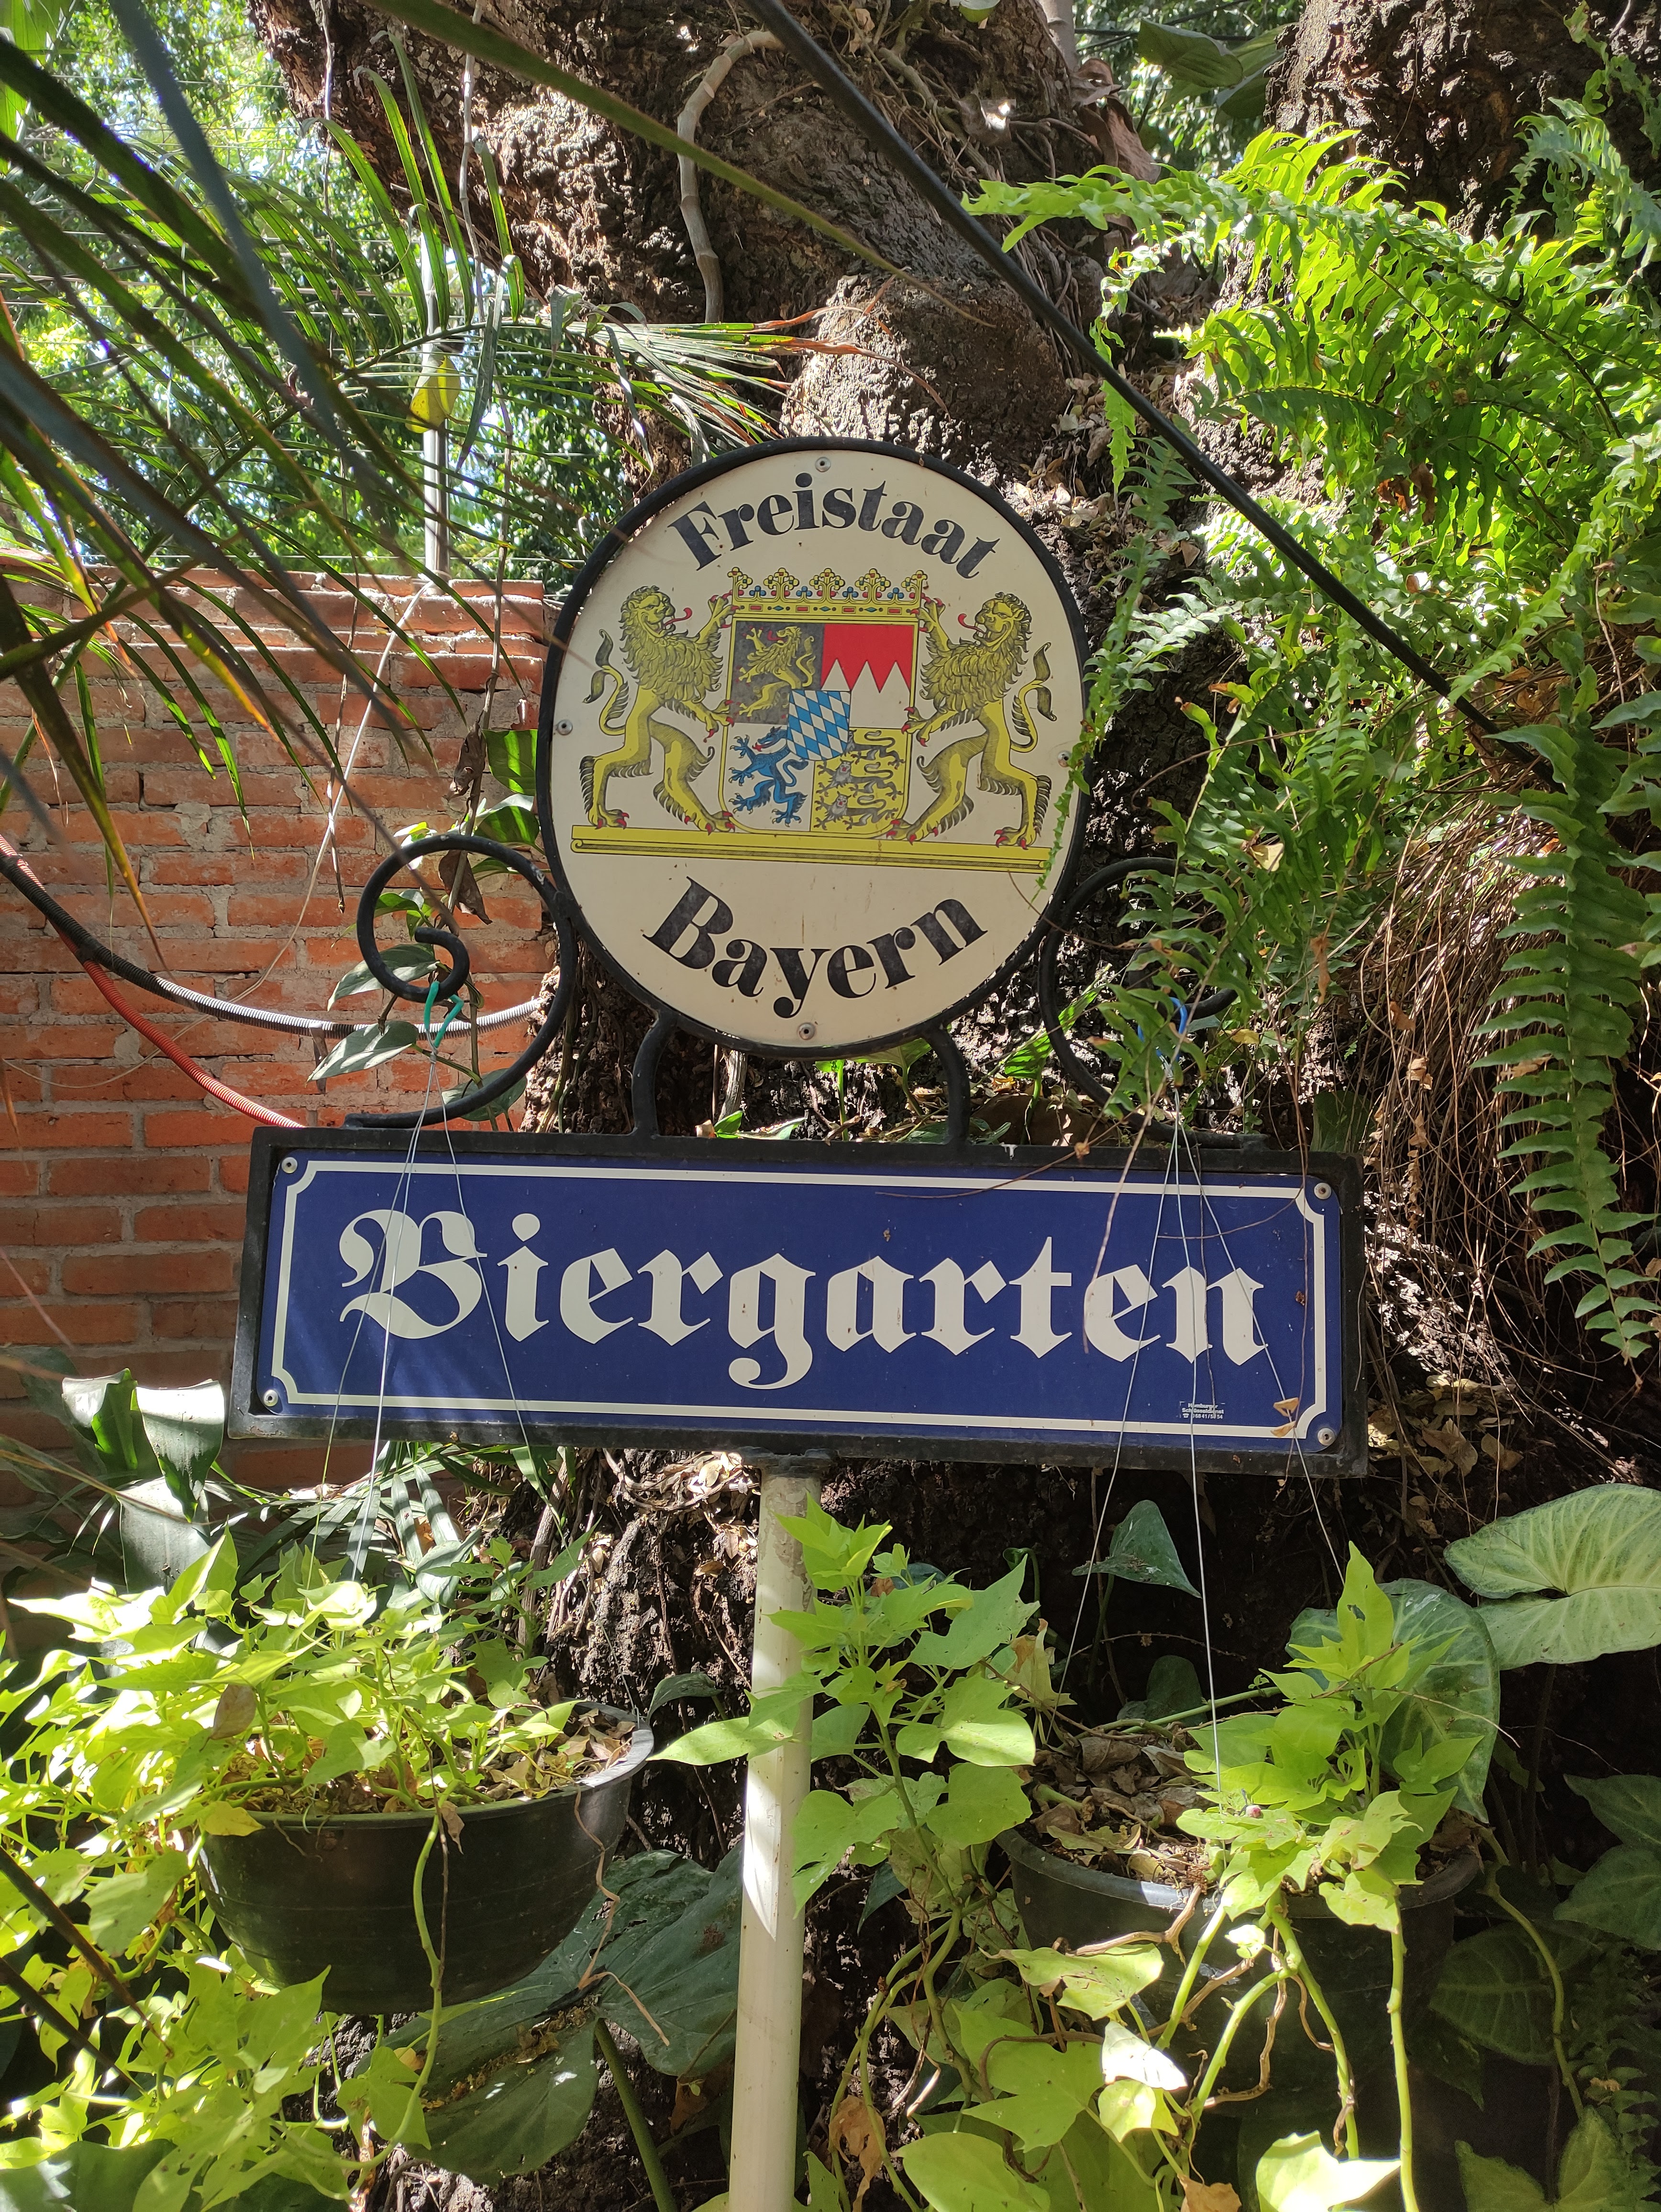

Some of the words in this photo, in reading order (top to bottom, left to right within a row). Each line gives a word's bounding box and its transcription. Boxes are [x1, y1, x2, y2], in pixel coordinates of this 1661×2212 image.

[667, 472, 1001, 579] Freistaat
[642, 876, 989, 1019] Bayern
[339, 1209, 1269, 1390] Biergarten
